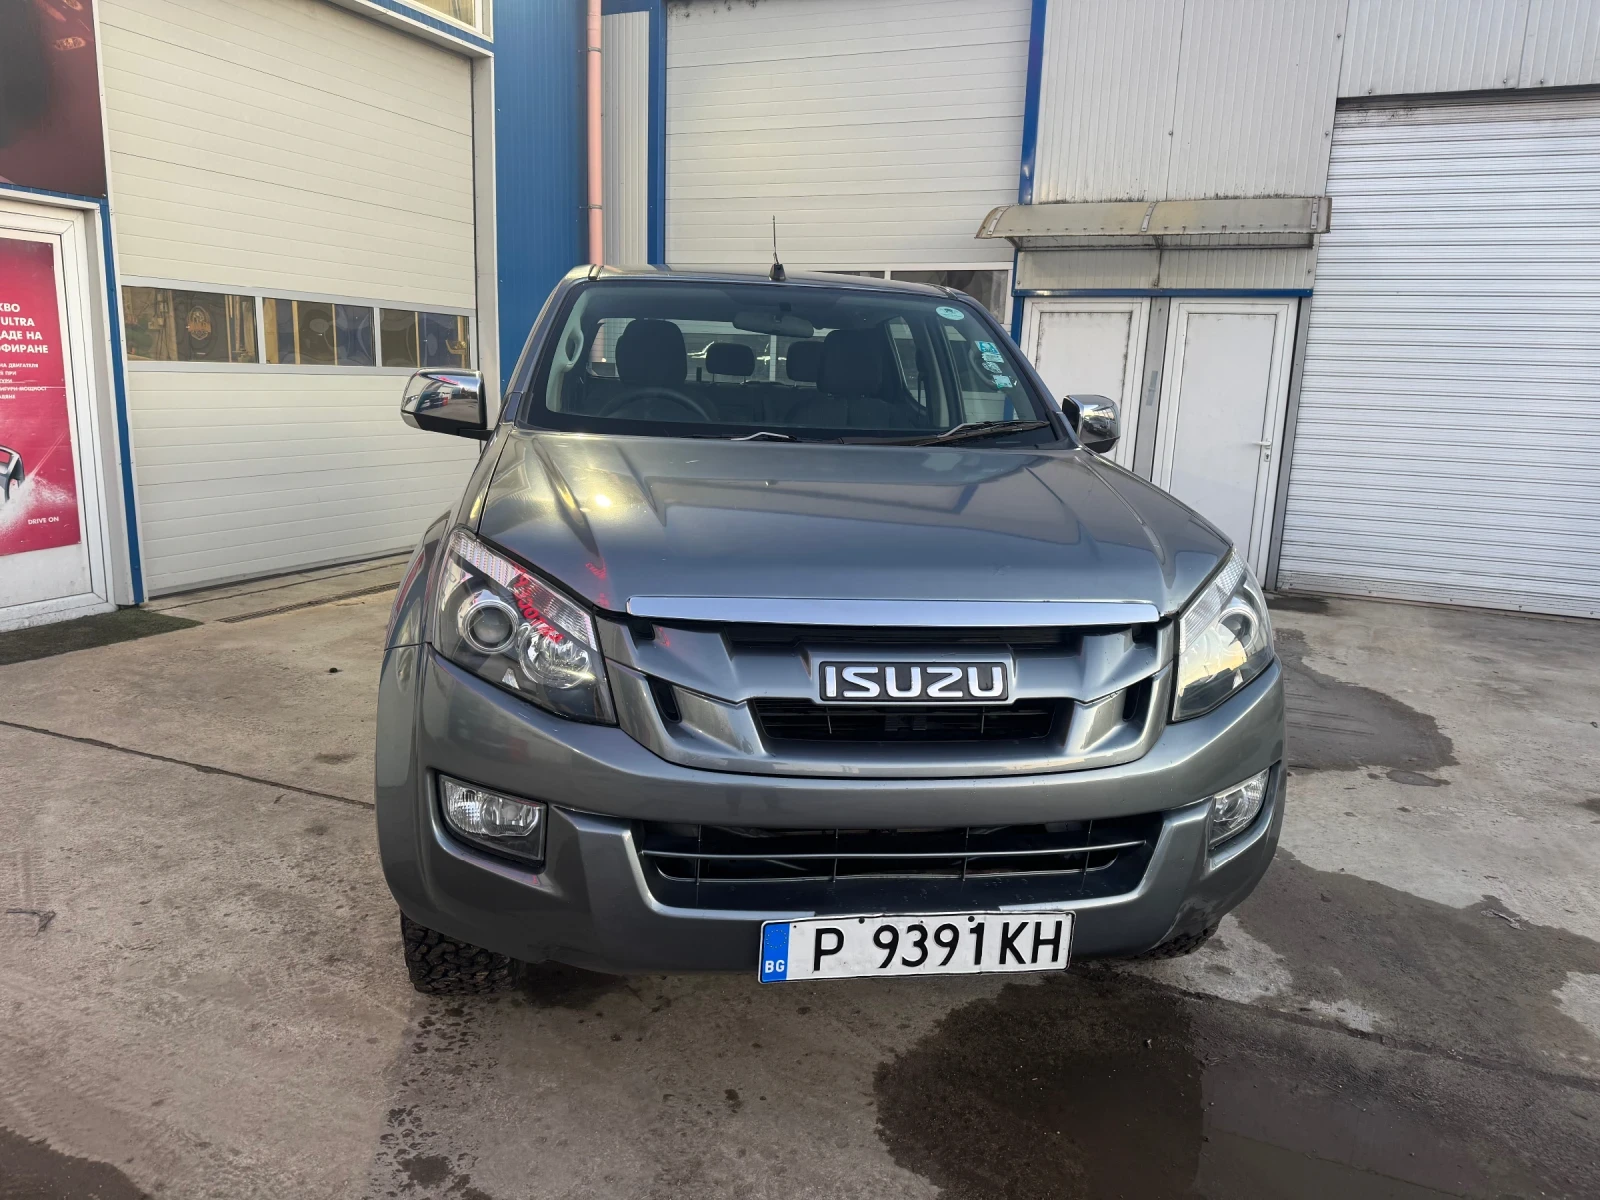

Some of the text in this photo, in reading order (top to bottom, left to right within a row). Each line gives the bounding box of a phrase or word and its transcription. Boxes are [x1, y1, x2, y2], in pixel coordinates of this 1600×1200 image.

[1, 316, 35, 326] ULTRA
[0, 330, 42, 341] АДЕ НА
[0, 343, 48, 353] ФИРАНЕ
[826, 666, 1003, 698] ISUZU
[765, 960, 785, 974] BG
